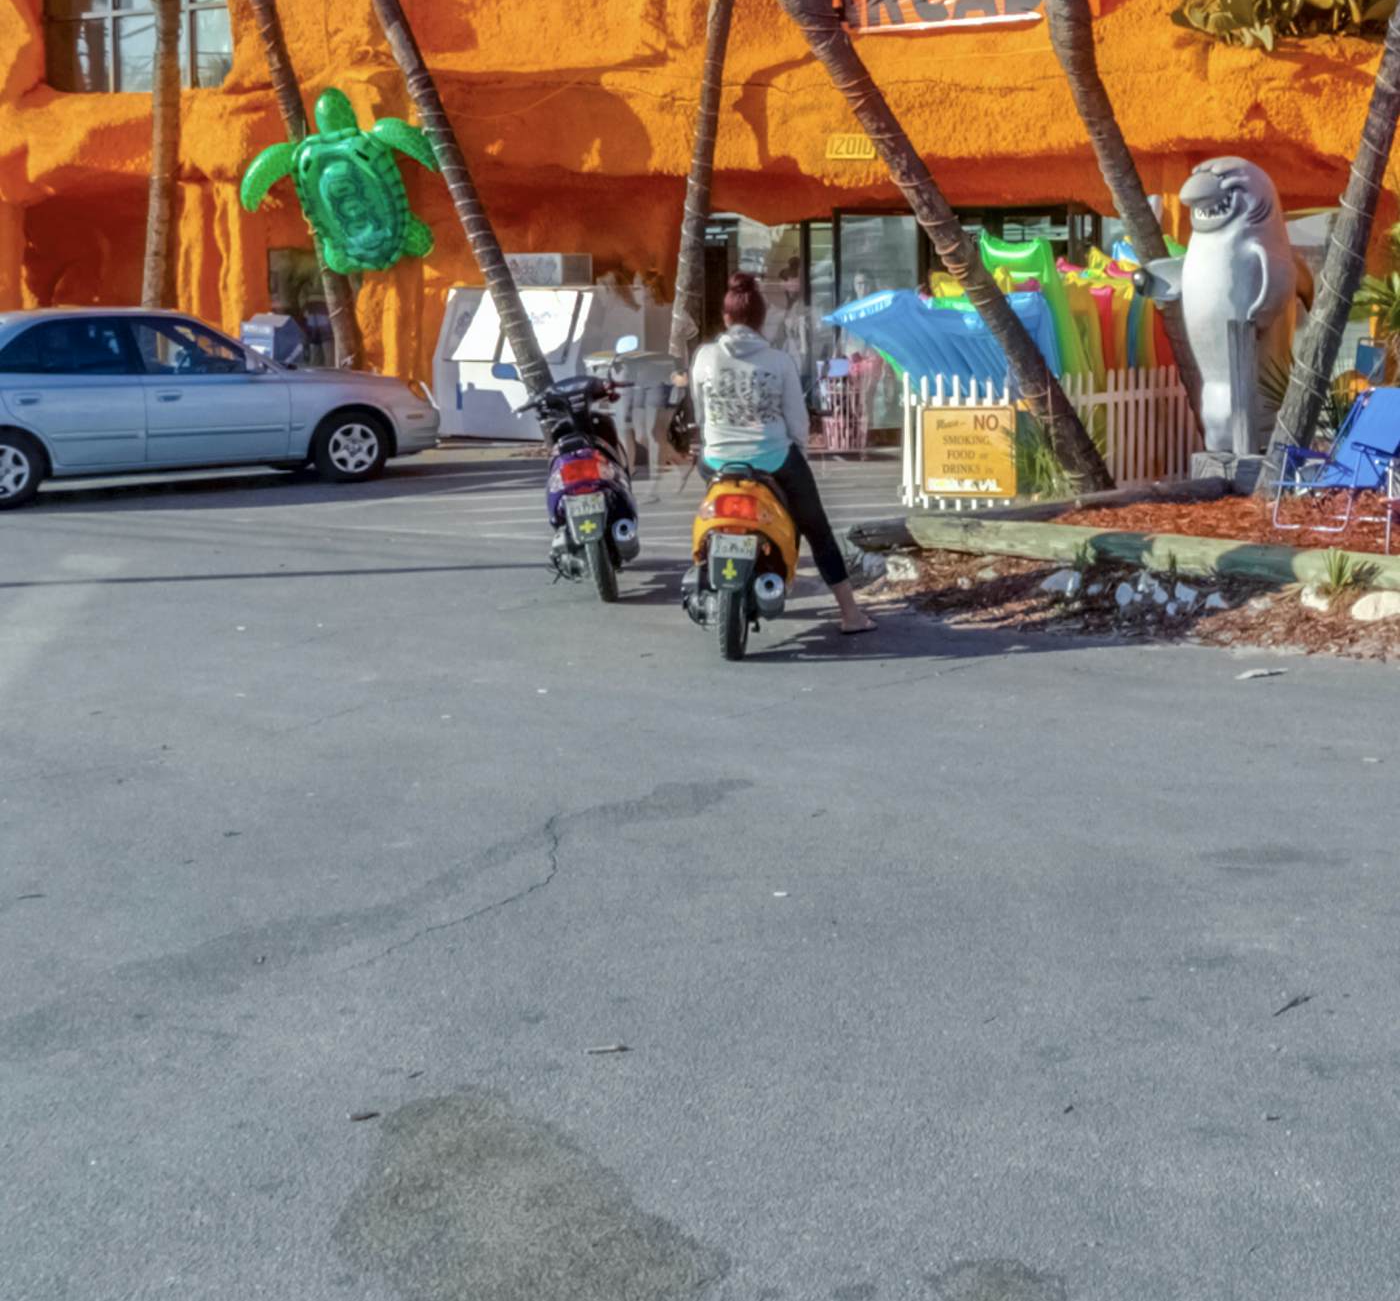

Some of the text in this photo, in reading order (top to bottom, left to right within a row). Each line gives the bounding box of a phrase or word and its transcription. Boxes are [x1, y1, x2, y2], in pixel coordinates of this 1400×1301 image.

[973, 414, 999, 431] NO
[947, 450, 976, 460] FOOD
[942, 464, 981, 474] DRINKS
